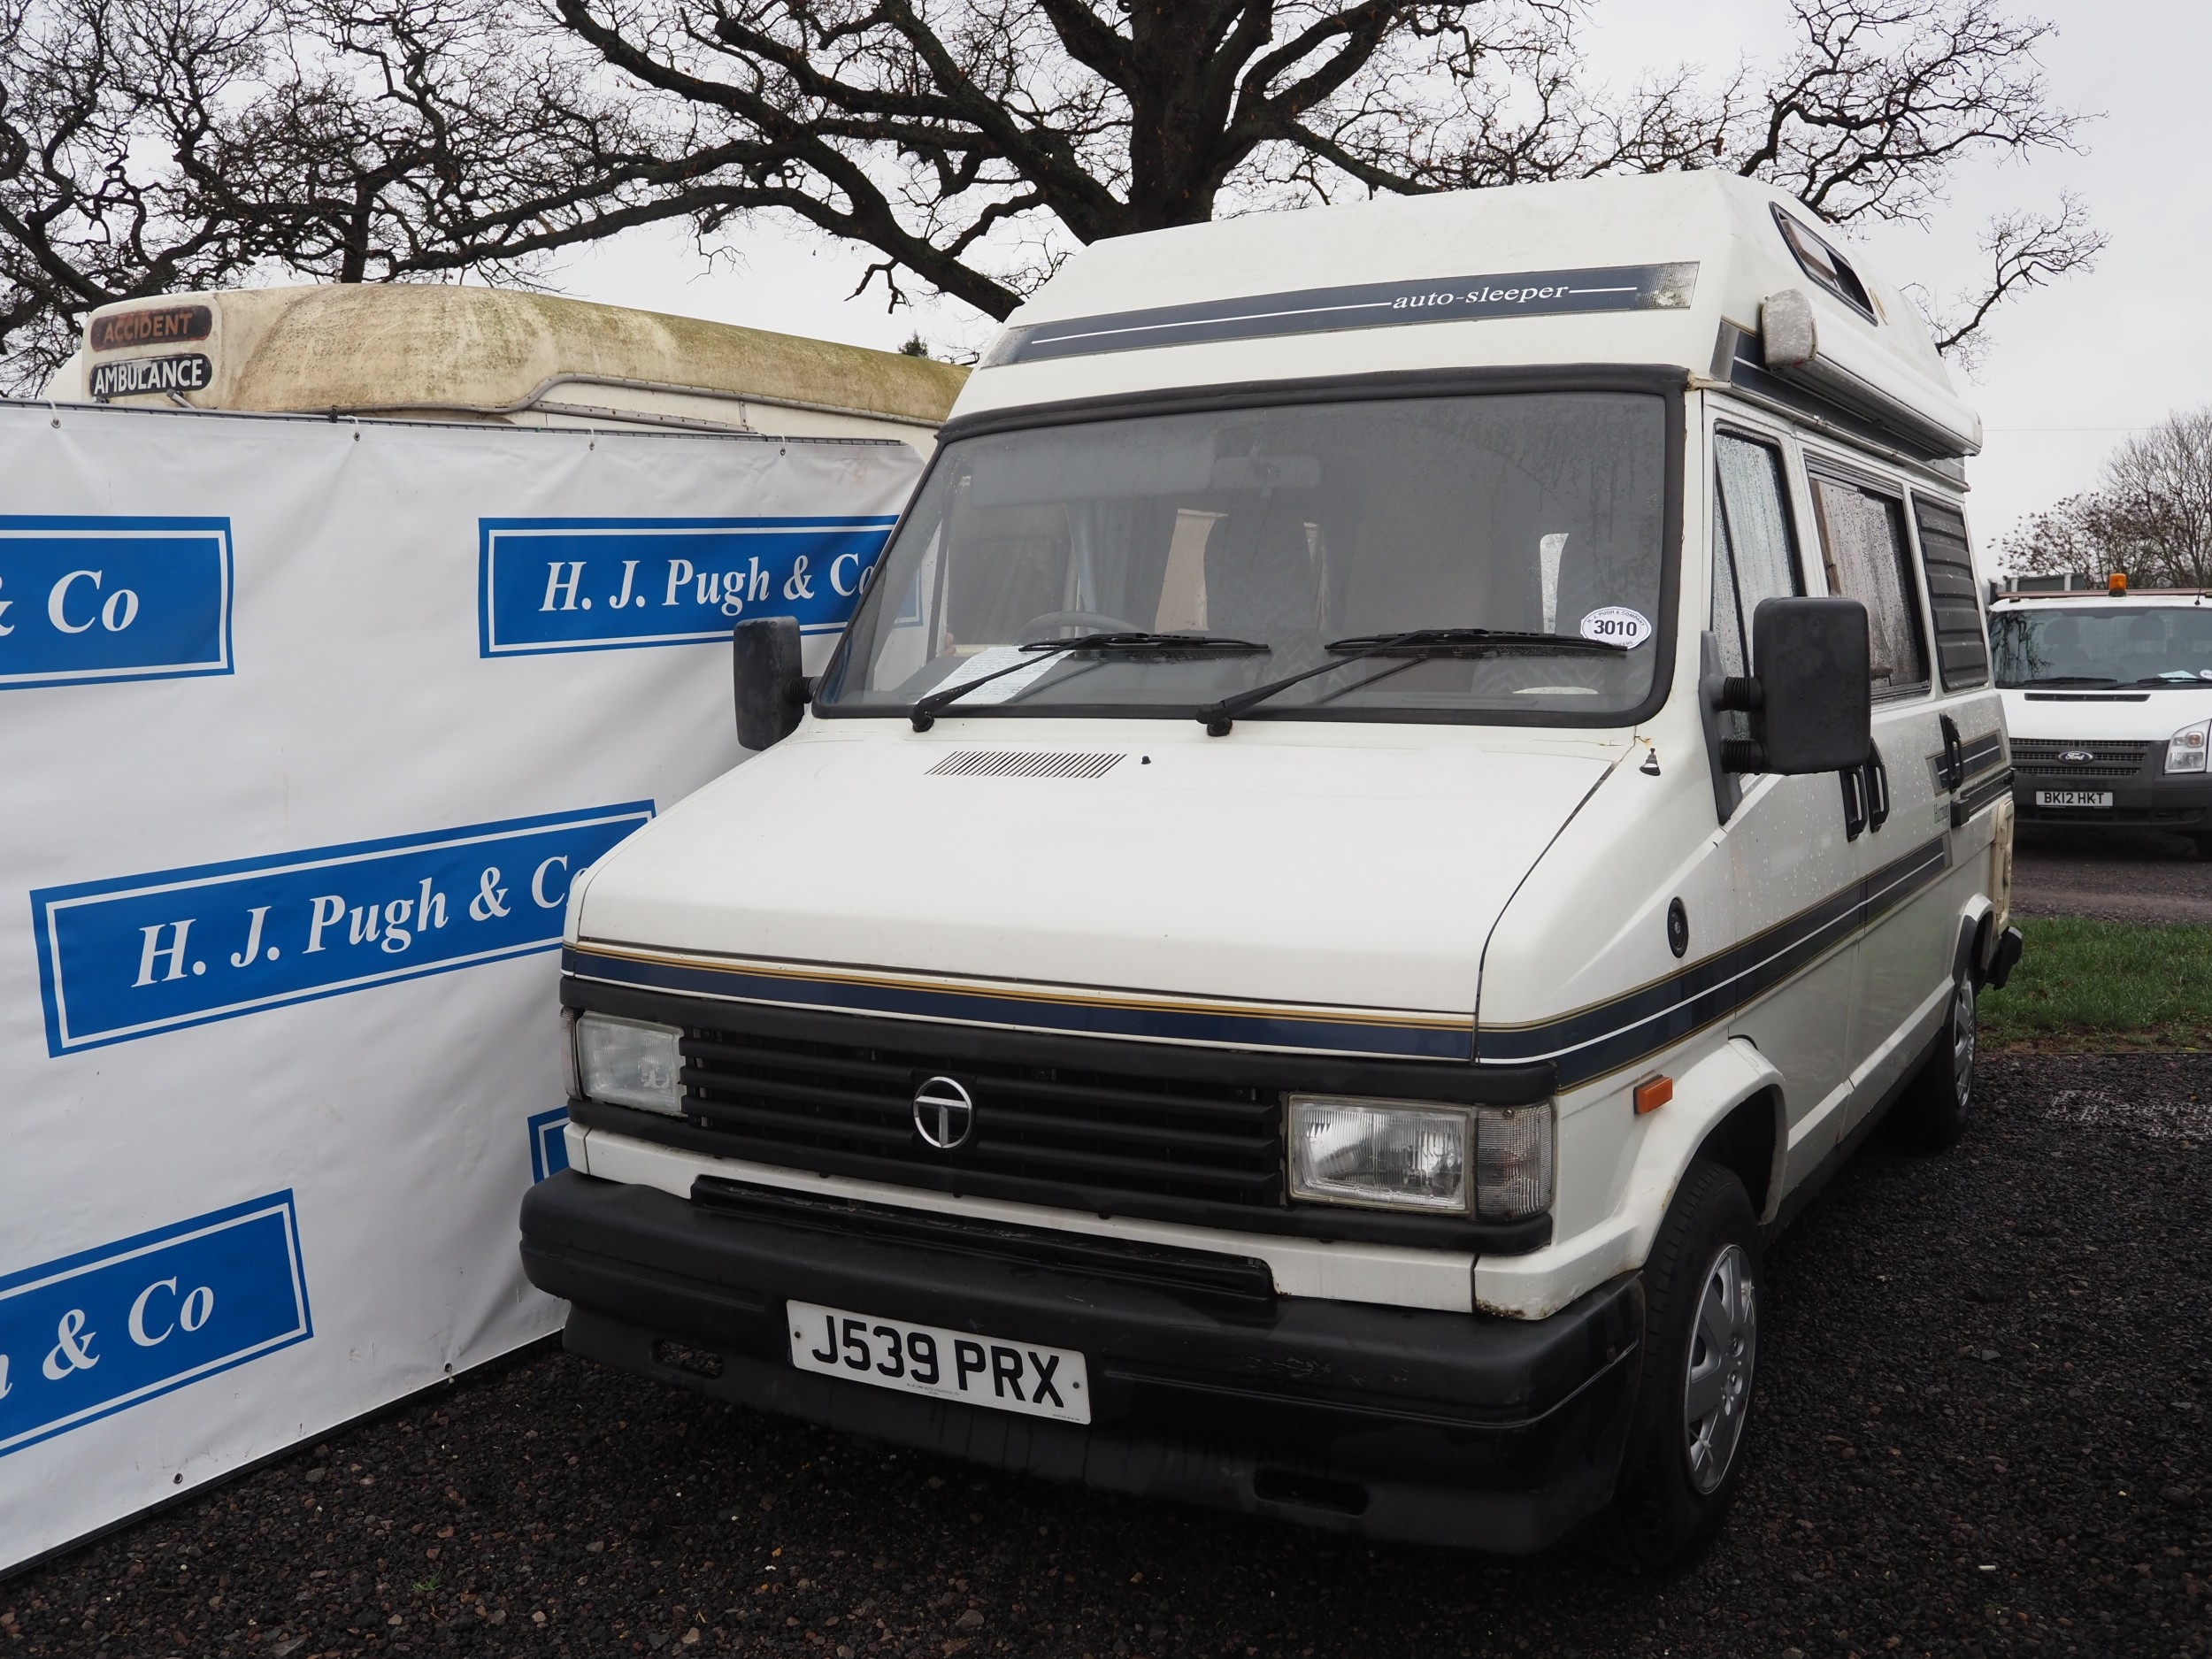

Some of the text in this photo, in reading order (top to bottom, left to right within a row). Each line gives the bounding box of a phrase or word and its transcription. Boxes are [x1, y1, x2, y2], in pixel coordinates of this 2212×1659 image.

[1393, 286, 1569, 309] auto-sleeper
[104, 313, 193, 343] ACCIDENT
[94, 358, 203, 395] AMBULANCE
[48, 570, 139, 634] Co
[538, 560, 592, 611] H.
[609, 559, 646, 610] J.
[662, 556, 770, 617] Pugh
[783, 555, 815, 601] &
[1594, 619, 1637, 636] 3010
[2064, 752, 2085, 761] Ford
[2044, 792, 2105, 804] BK12 HKT
[131, 855, 589, 987] H. J. Pugh & C
[42, 1309, 100, 1380] &
[128, 1276, 214, 1347] Co
[811, 1315, 1064, 1409] J539 PRX
